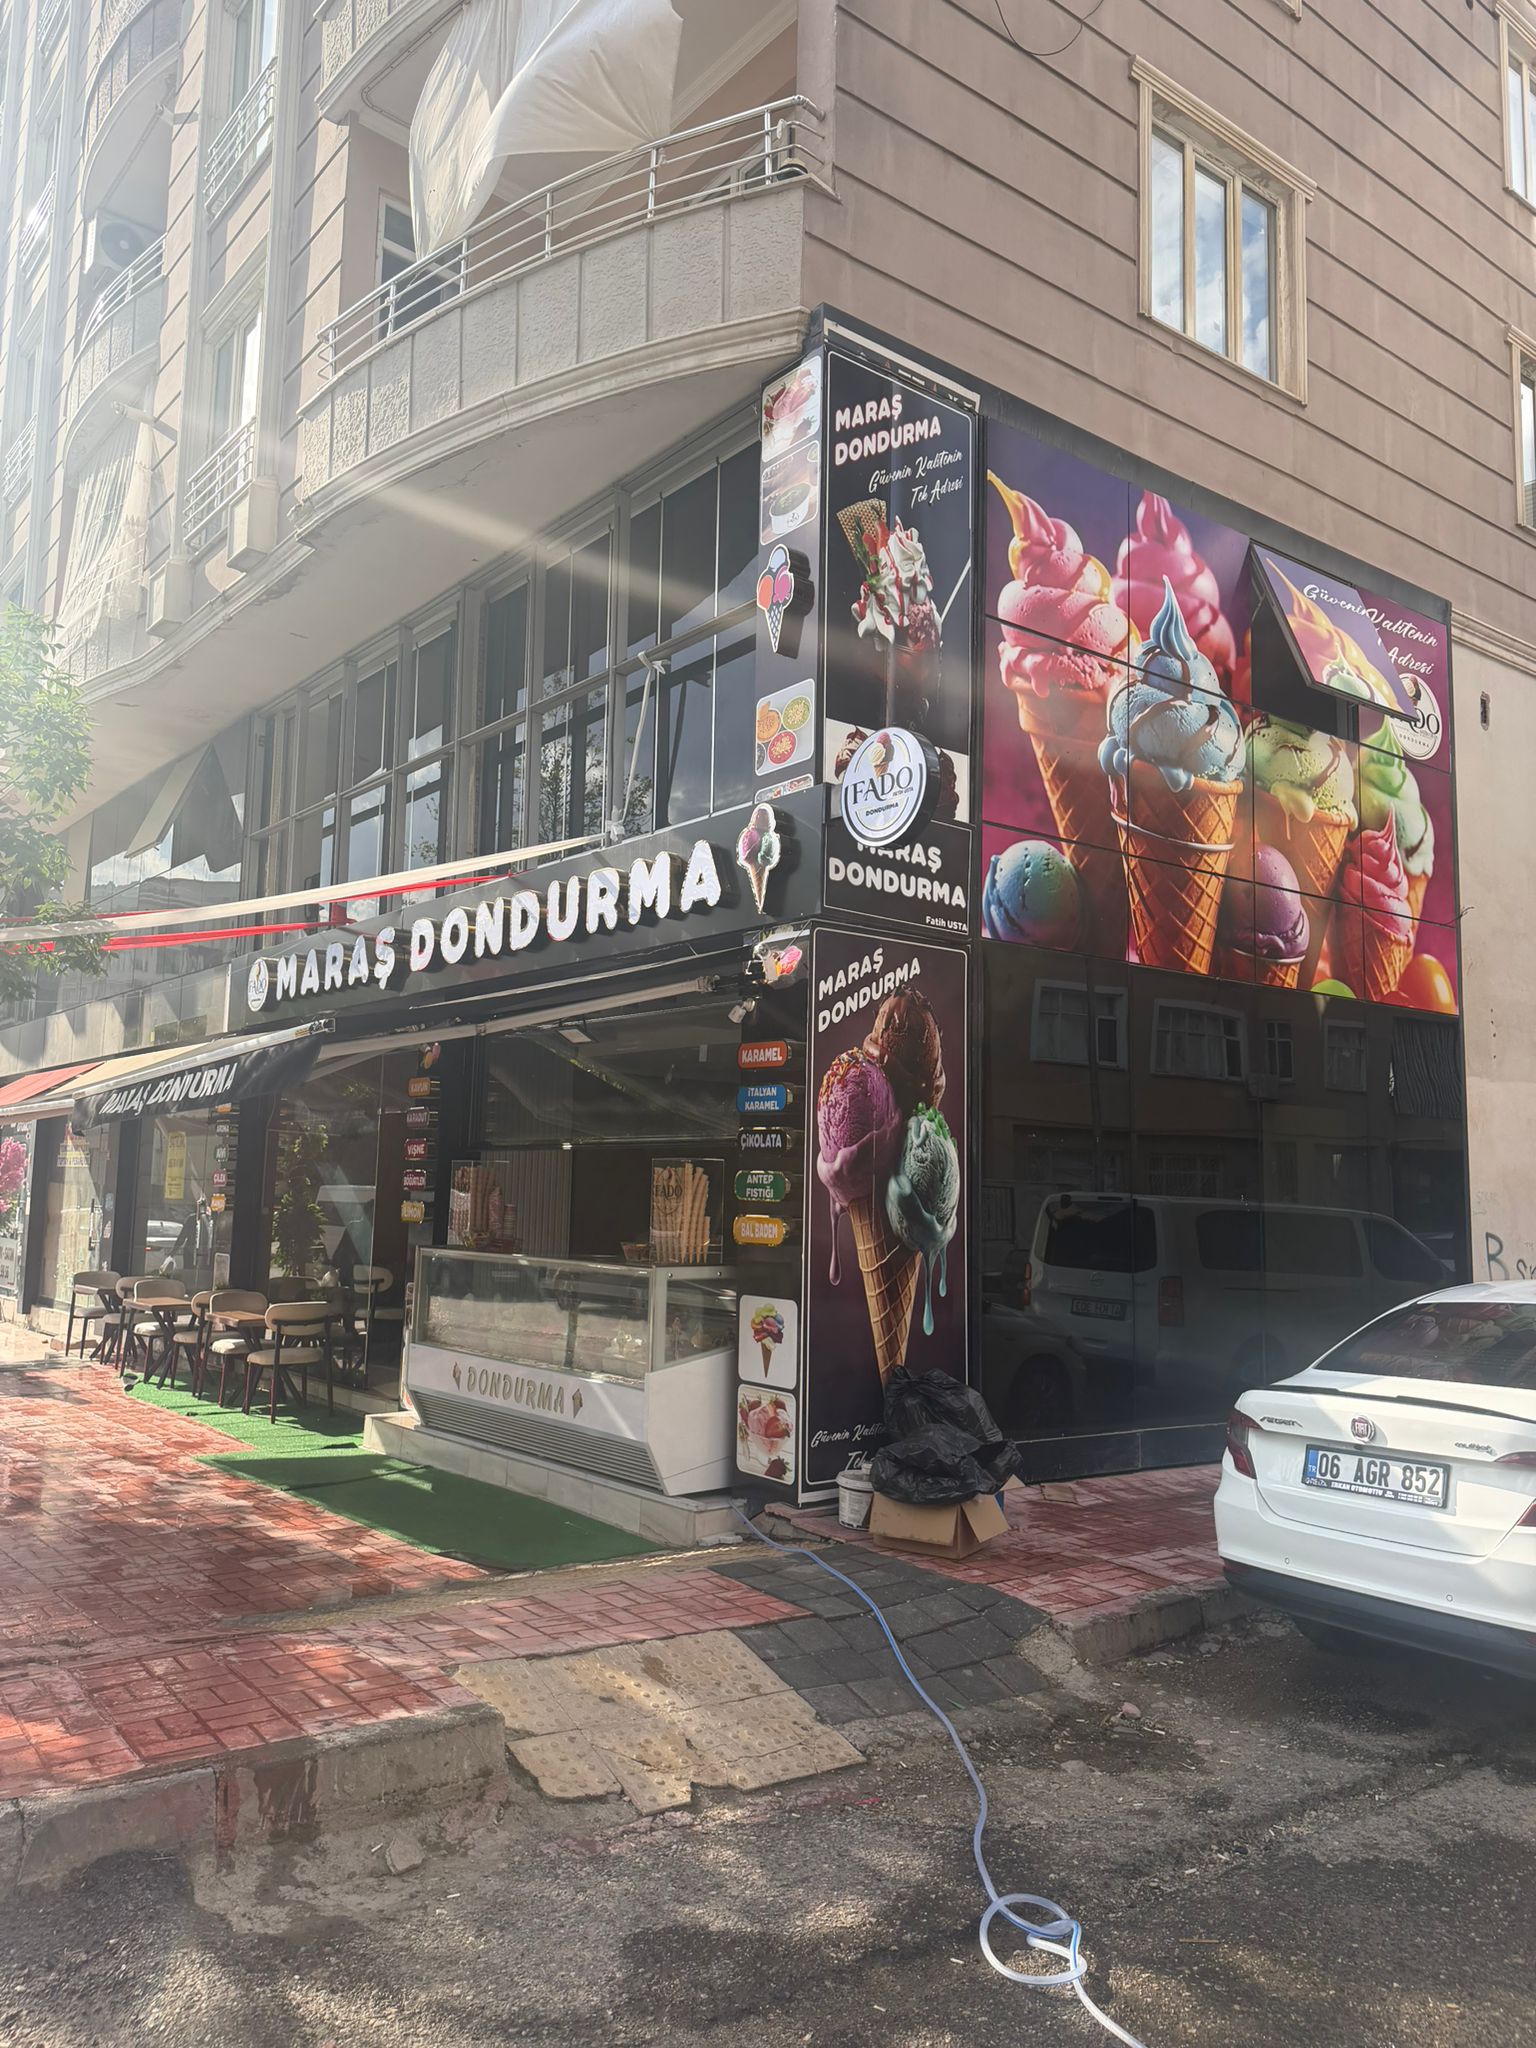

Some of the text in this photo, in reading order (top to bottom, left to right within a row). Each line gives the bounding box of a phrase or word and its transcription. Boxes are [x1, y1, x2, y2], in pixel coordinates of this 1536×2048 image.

[835, 394, 902, 432] MARAŞ
[834, 416, 941, 466] DONDURMA
[911, 476, 964, 509] Tek Adresi
[1388, 646, 1435, 675] Adresi
[852, 766, 913, 805] FADO
[865, 802, 899, 816] DONDURMA
[828, 857, 967, 909] DONDURMA
[275, 839, 723, 1001] MARAŞ DONDURMA
[926, 915, 968, 932] Fatih USTA
[818, 947, 884, 1001] MARAŞ
[818, 957, 921, 1033] DONDURMA
[741, 1045, 783, 1063] KARAMEL
[744, 1100, 780, 1111] KARAMEL
[746, 1174, 774, 1185] ANTEP
[467, 1366, 565, 1415] DONDURMA
[1308, 1453, 1441, 1496] TR 06 AGR 852
